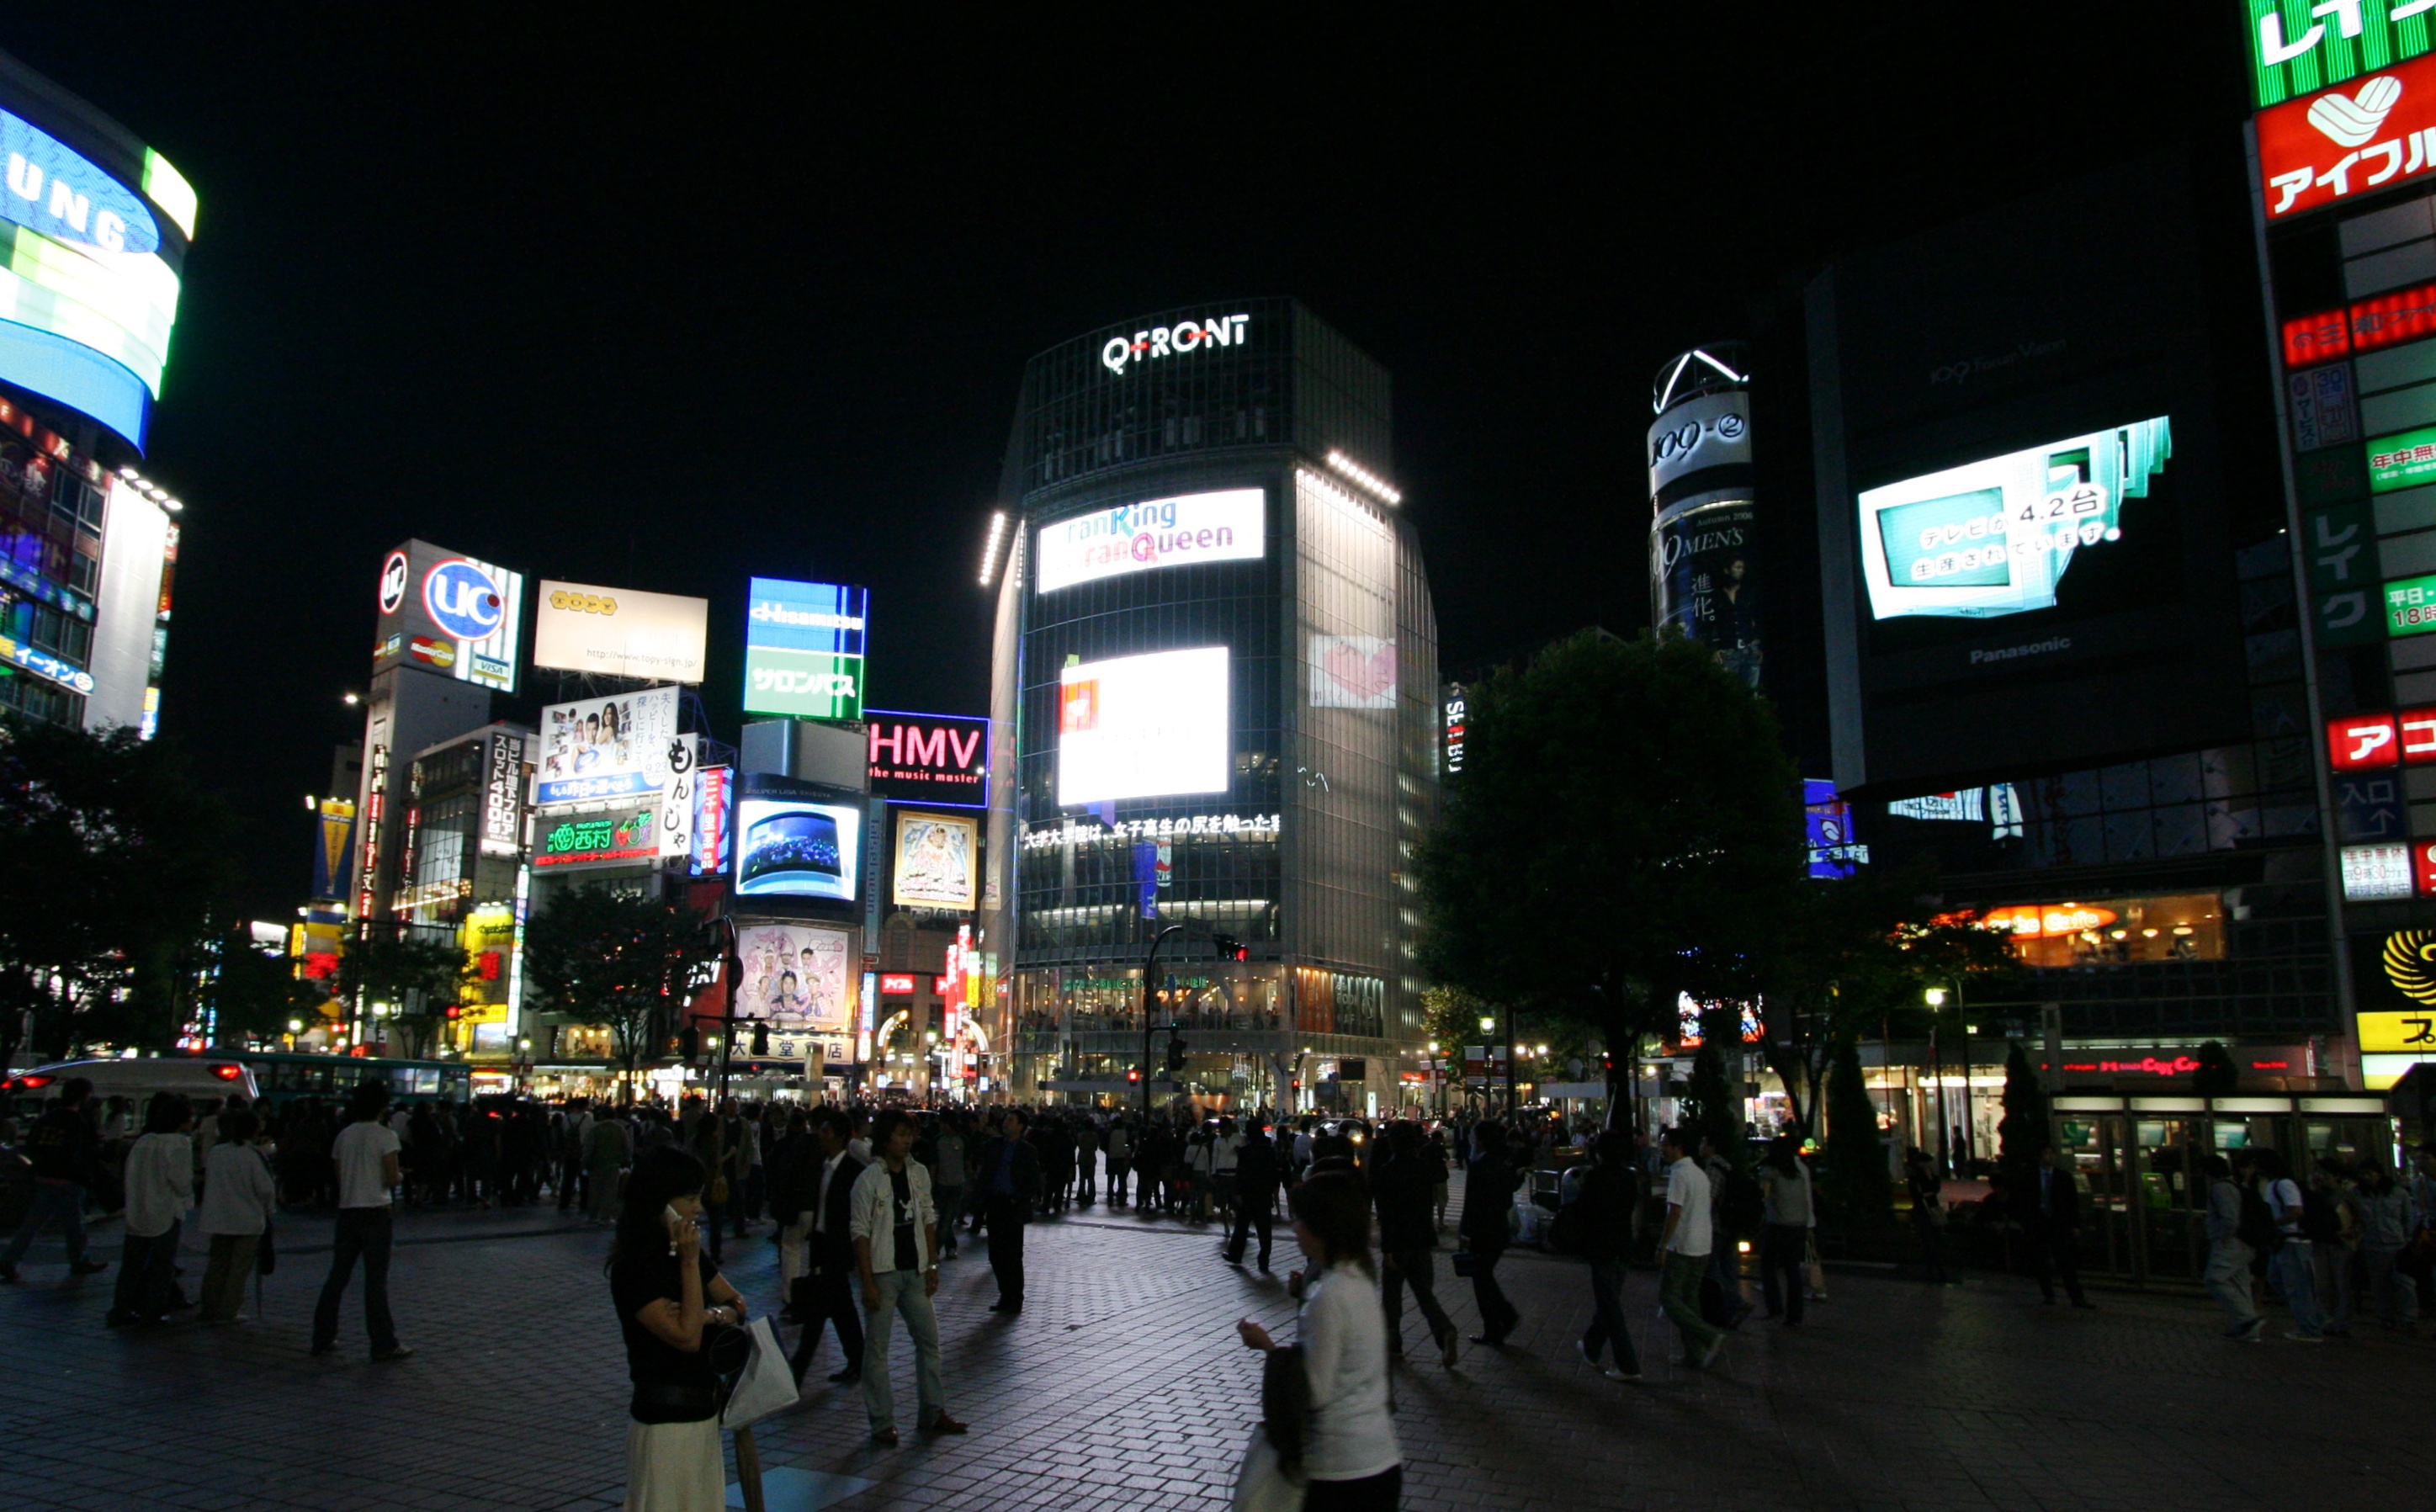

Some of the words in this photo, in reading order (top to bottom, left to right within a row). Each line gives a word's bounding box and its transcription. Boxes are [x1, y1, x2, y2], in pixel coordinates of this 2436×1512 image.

[2270, 126, 2436, 214] アイフル
[7, 153, 125, 252] UNG
[1102, 314, 1249, 374] QFRONT
[2371, 445, 2436, 470] 年中無
[1696, 514, 1731, 528] Autumn
[1733, 512, 1753, 521] 2006
[1915, 527, 2117, 576] 生産されています。
[2316, 514, 2366, 629] レイク
[555, 597, 613, 610] TOPY
[1691, 573, 1715, 621] 進化。
[750, 602, 863, 629] Hisamitsu
[411, 642, 454, 661] MasterCard
[1970, 636, 2072, 665] Panasonic
[16, 648, 76, 682] イーオン
[480, 661, 503, 675] VISA
[752, 668, 856, 698] サロンパス
[870, 723, 979, 768] HMV
[869, 767, 889, 777] the
[894, 769, 930, 780] music
[935, 772, 979, 783] master
[665, 738, 693, 849] もんじゃ
[2343, 779, 2395, 805] 入口
[575, 828, 612, 851] 西村
[884, 978, 913, 989] アイフル
[732, 1039, 841, 1059] 大堂店
